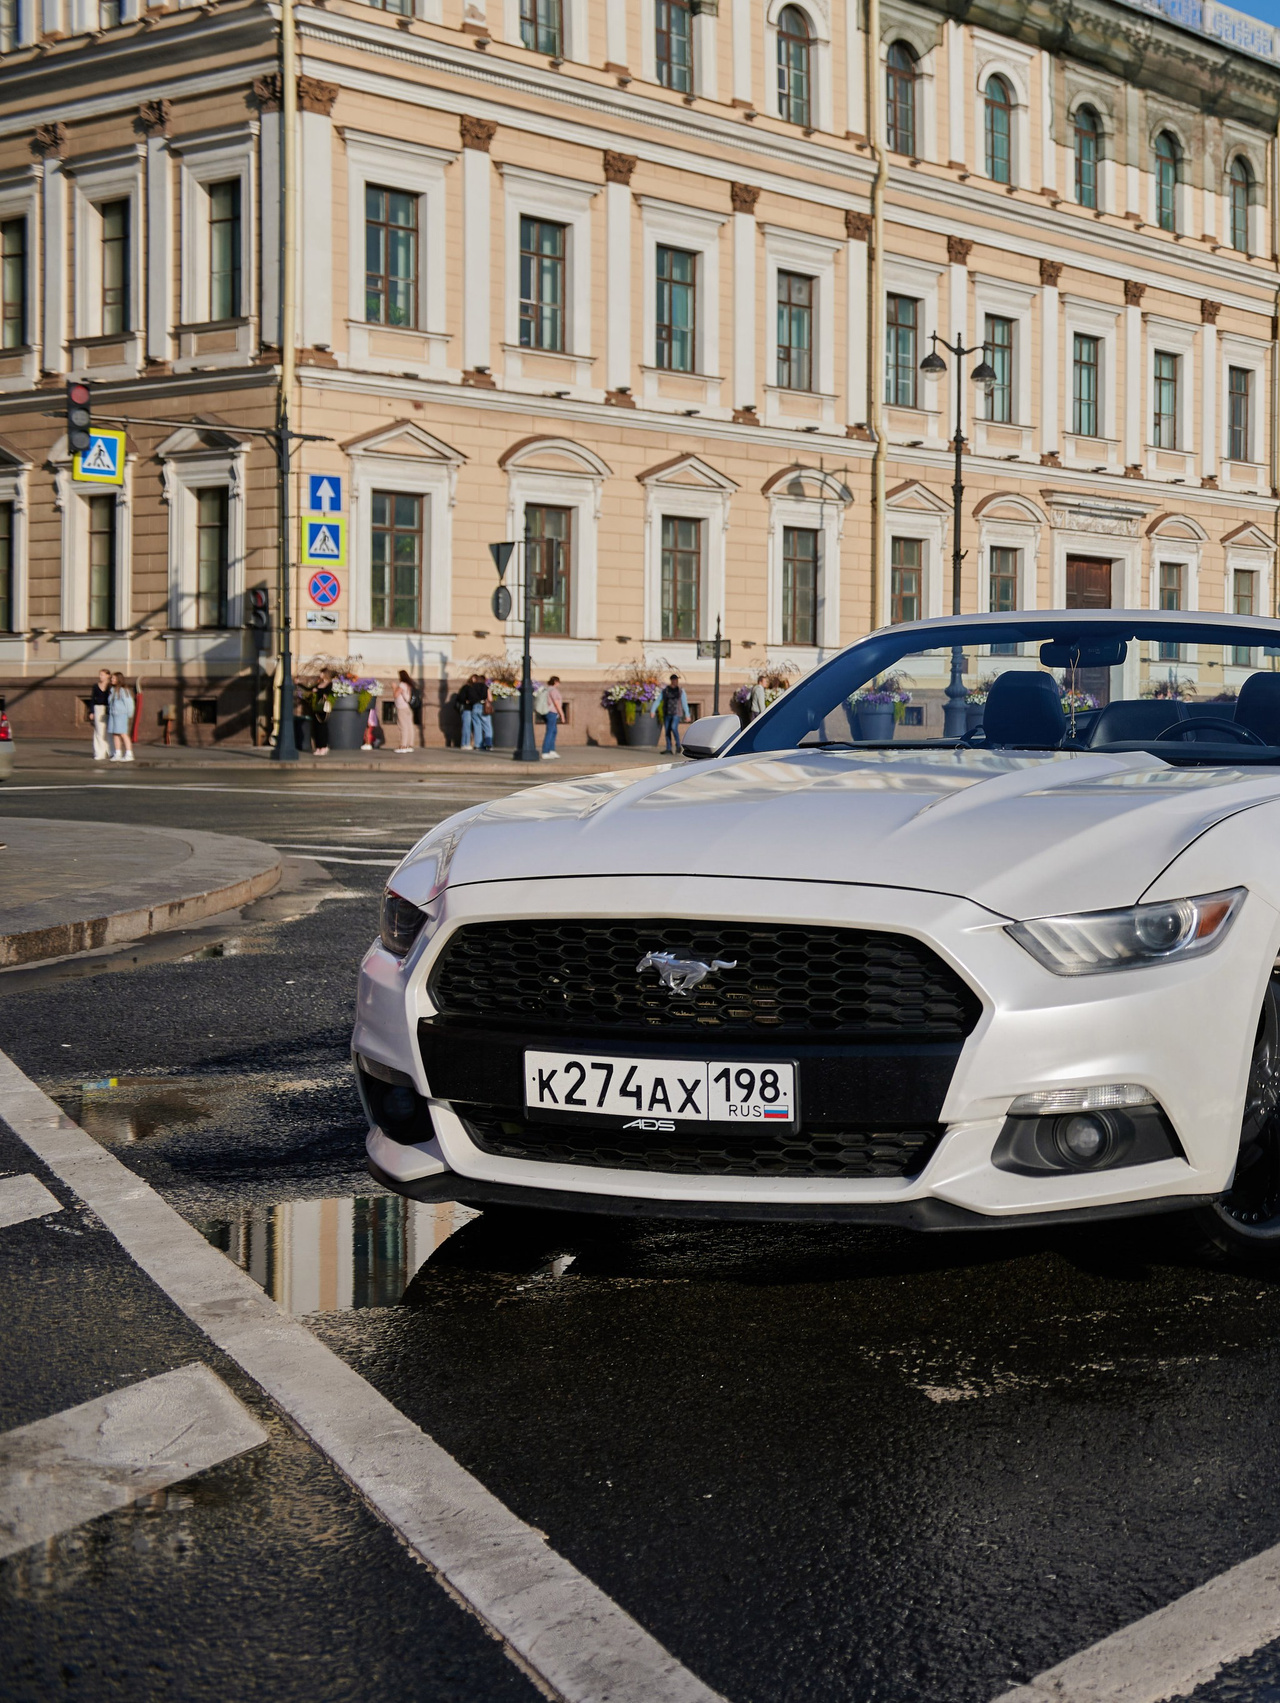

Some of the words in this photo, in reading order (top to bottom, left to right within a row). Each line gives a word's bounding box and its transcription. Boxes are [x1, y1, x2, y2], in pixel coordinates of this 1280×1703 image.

[713, 1067, 780, 1103] 198
[728, 1104, 762, 1118] RUS
[622, 1119, 676, 1132] ADS
